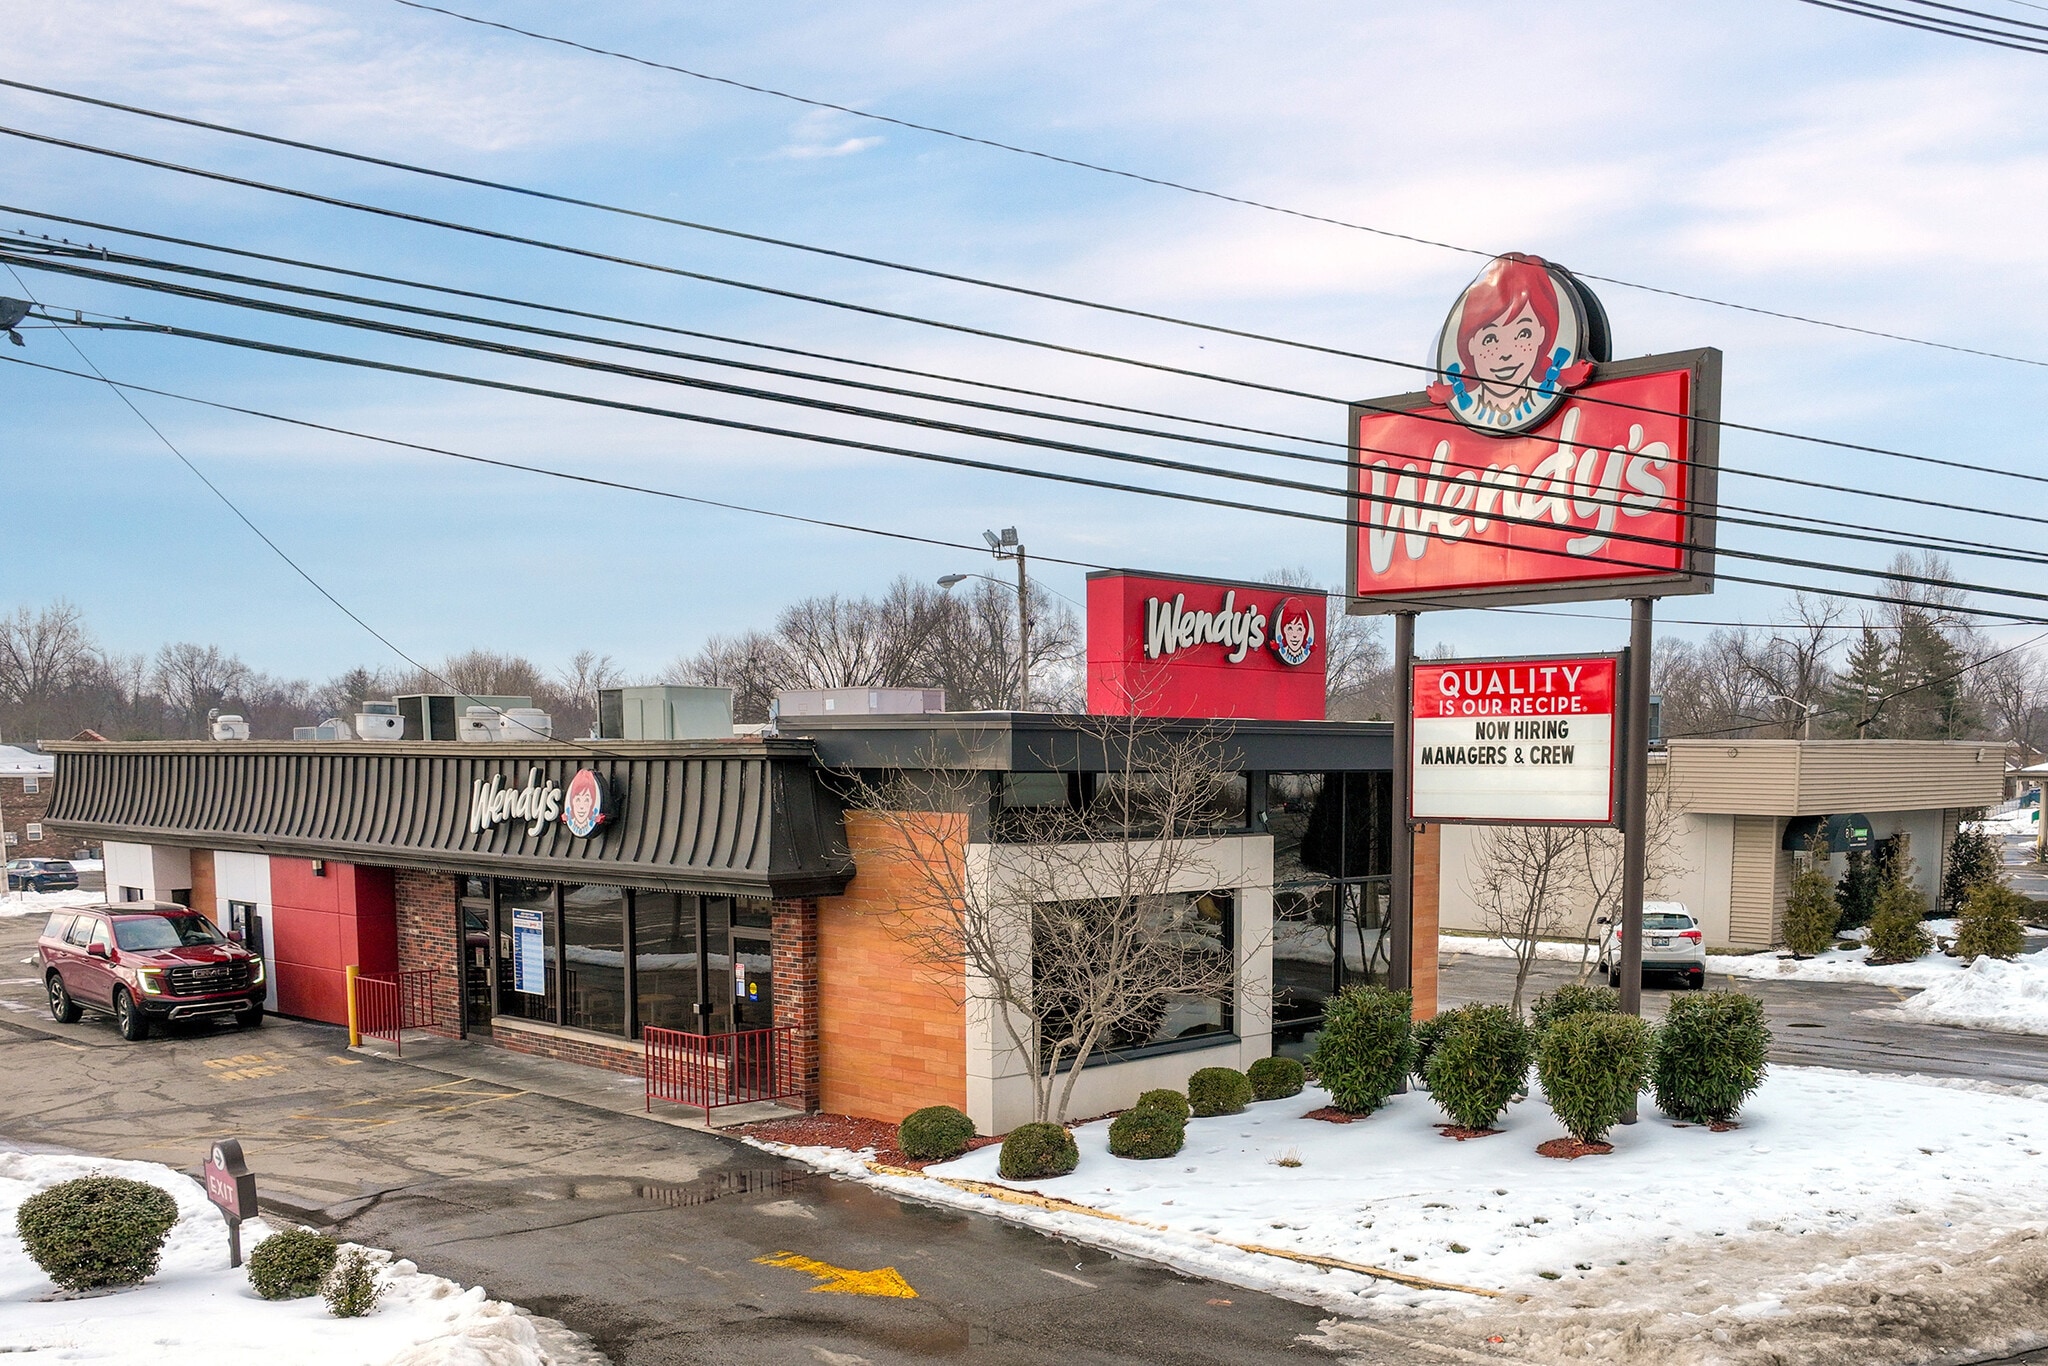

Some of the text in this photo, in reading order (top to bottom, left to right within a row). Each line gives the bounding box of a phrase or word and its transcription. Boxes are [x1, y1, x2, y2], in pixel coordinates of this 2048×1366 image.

[1369, 406, 1671, 575] Wendy's
[1147, 590, 1266, 664] Wendy's
[1438, 666, 1582, 699] QUALITY
[1439, 700, 1455, 715] IS
[1462, 699, 1503, 715] OUR
[1475, 720, 1569, 740] NOW HIRING
[1421, 745, 1575, 765] MANAGERS & CREW
[470, 767, 562, 837] Wendy's
[209, 1175, 233, 1203] EXIT
